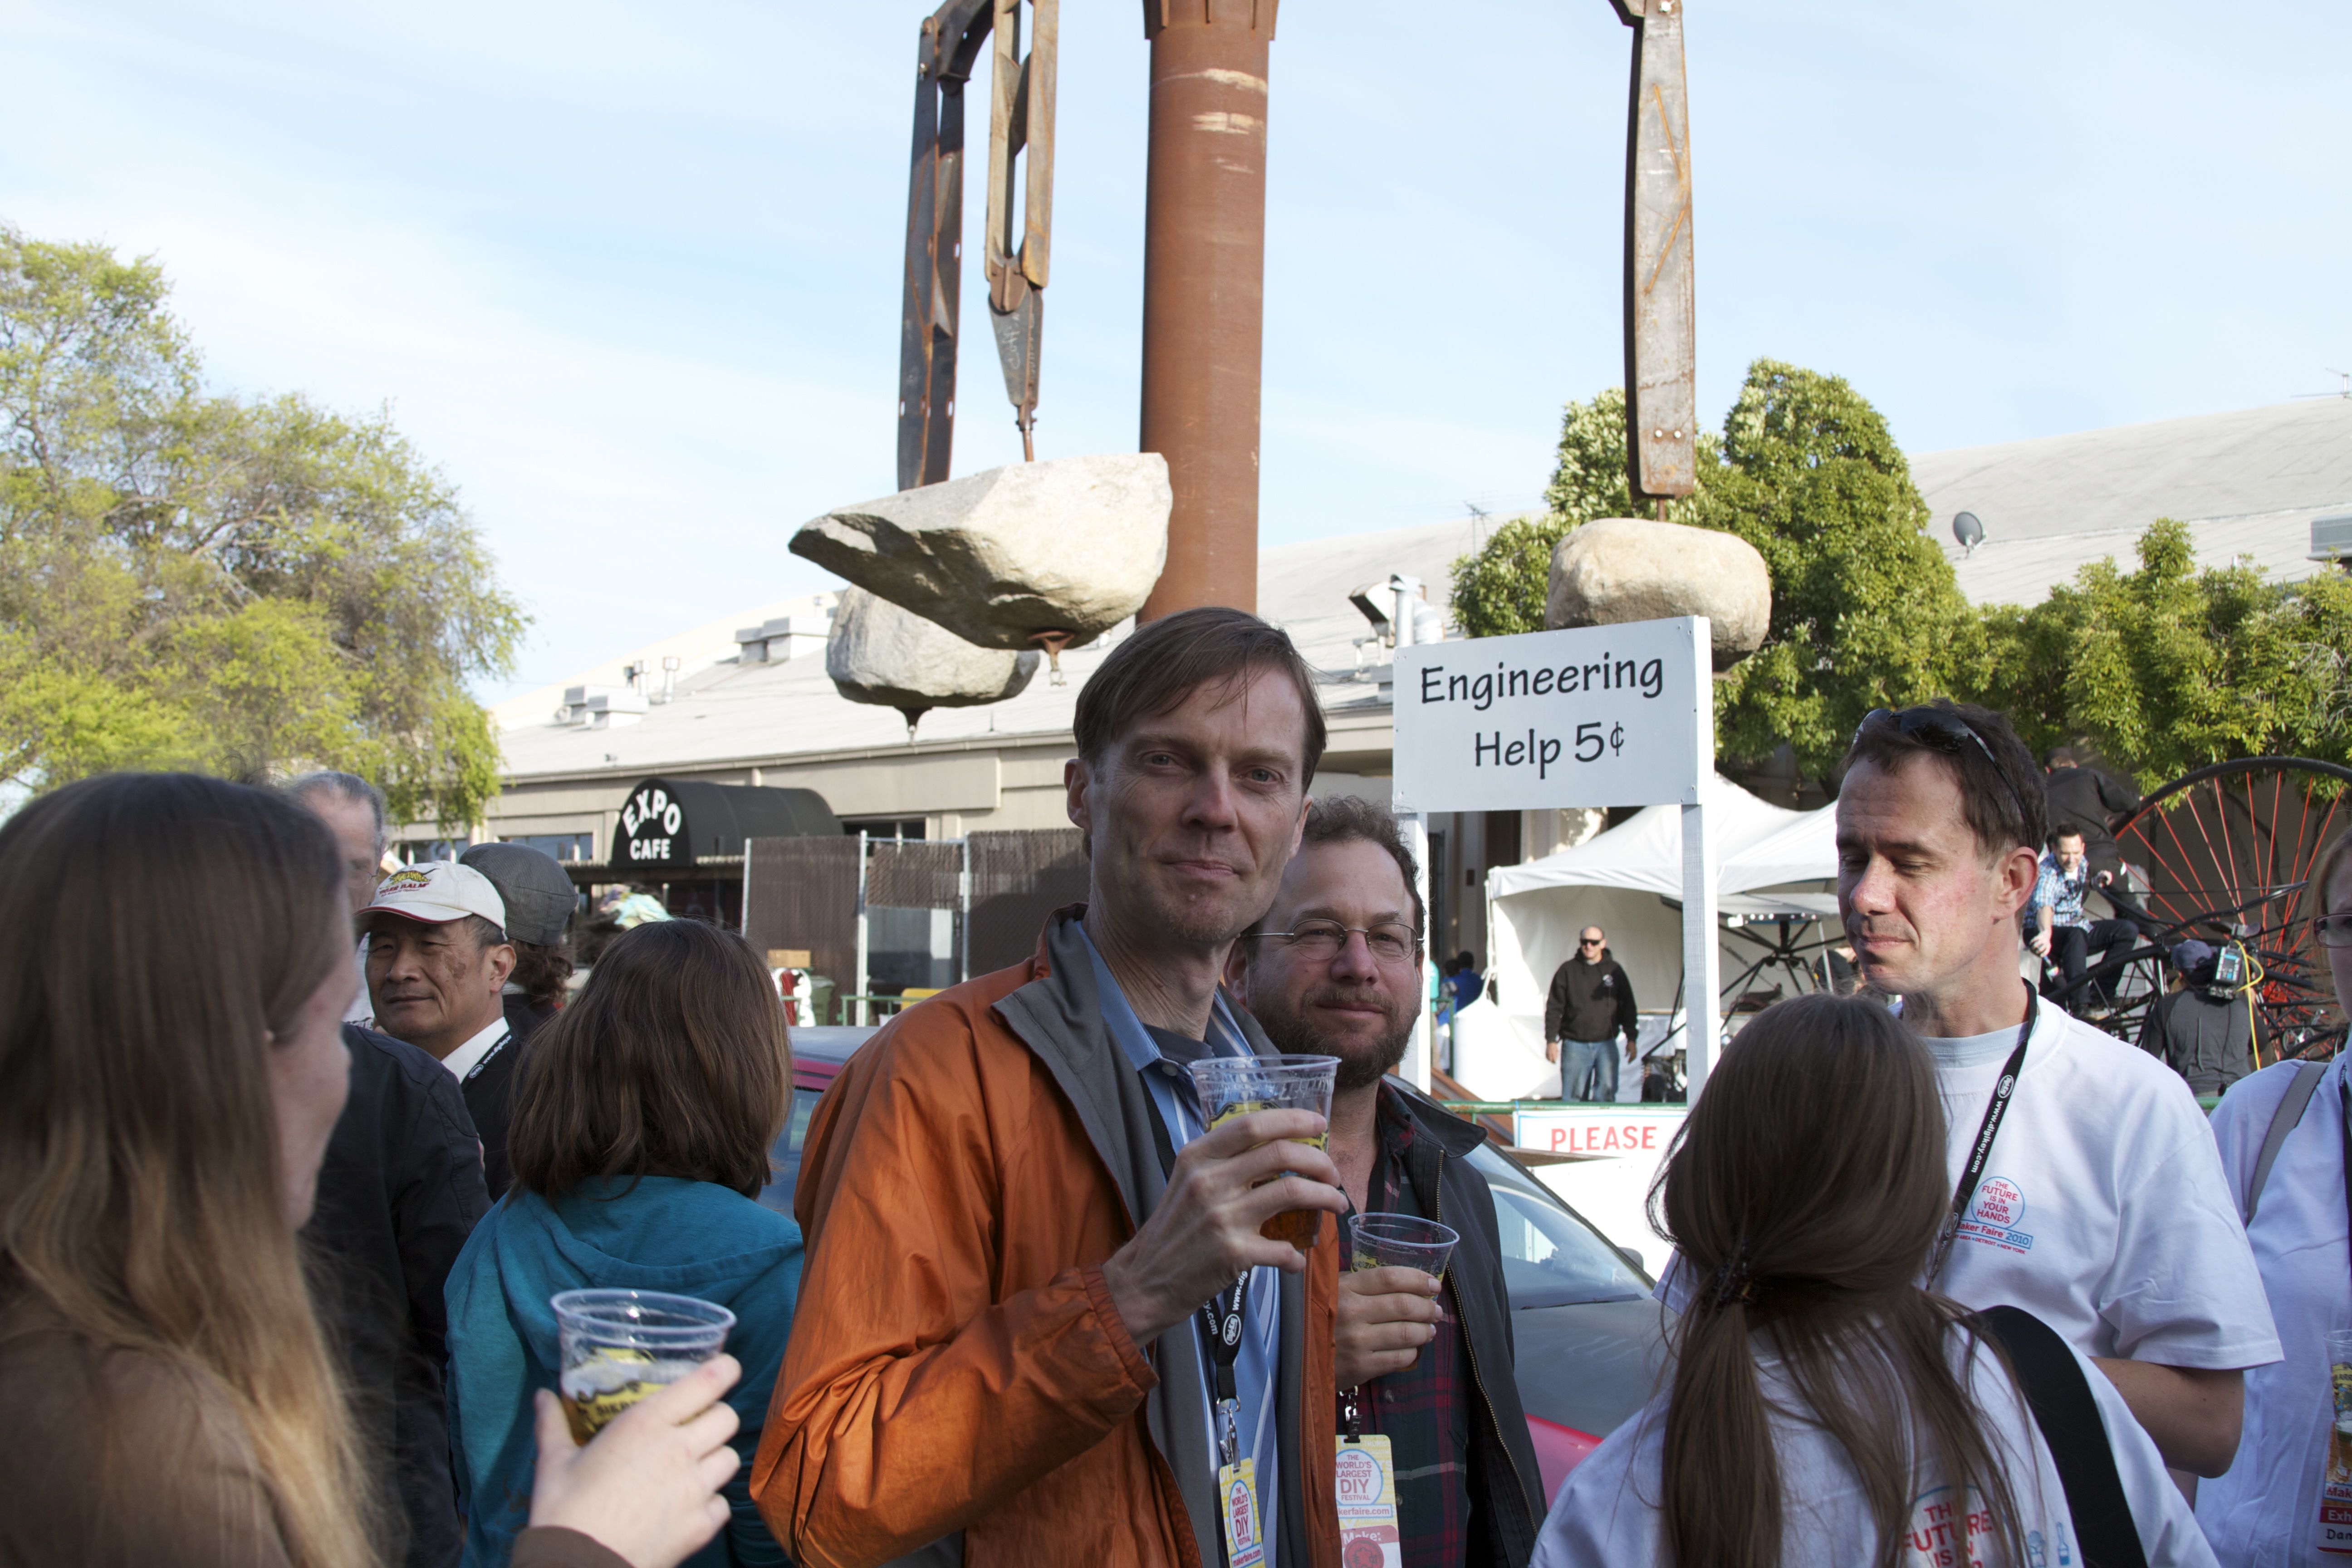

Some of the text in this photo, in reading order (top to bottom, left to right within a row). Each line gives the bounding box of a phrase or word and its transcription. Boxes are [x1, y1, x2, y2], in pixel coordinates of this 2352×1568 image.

[1421, 652, 1662, 710] Engineering
[1475, 721, 1624, 779] Help 5¢
[622, 789, 682, 838] EXPO
[630, 838, 671, 860] CAFE
[1550, 1126, 1657, 1153] PLEASE
[1971, 1101, 2004, 1173] www.digikey.com
[1981, 1186, 2018, 1201] FUTURE
[1995, 1181, 2009, 1190] THE
[1976, 1209, 2010, 1224] HANDS
[1983, 1201, 2009, 1215] YOUR
[1981, 1226, 2004, 1238] Faire
[2006, 1232, 2029, 1245] 2010
[1975, 1237, 1996, 1246] DETROIT
[2013, 1247, 2026, 1255] YORK
[1340, 1478, 1370, 1494] DIY
[1231, 1493, 1248, 1507] WORLD'S
[1232, 1504, 1249, 1519] LARGEST
[1235, 1515, 1249, 1538] DIY
[1237, 1535, 1251, 1546] FESTIVAL
[1232, 1548, 1261, 1567] makerfaire.com
